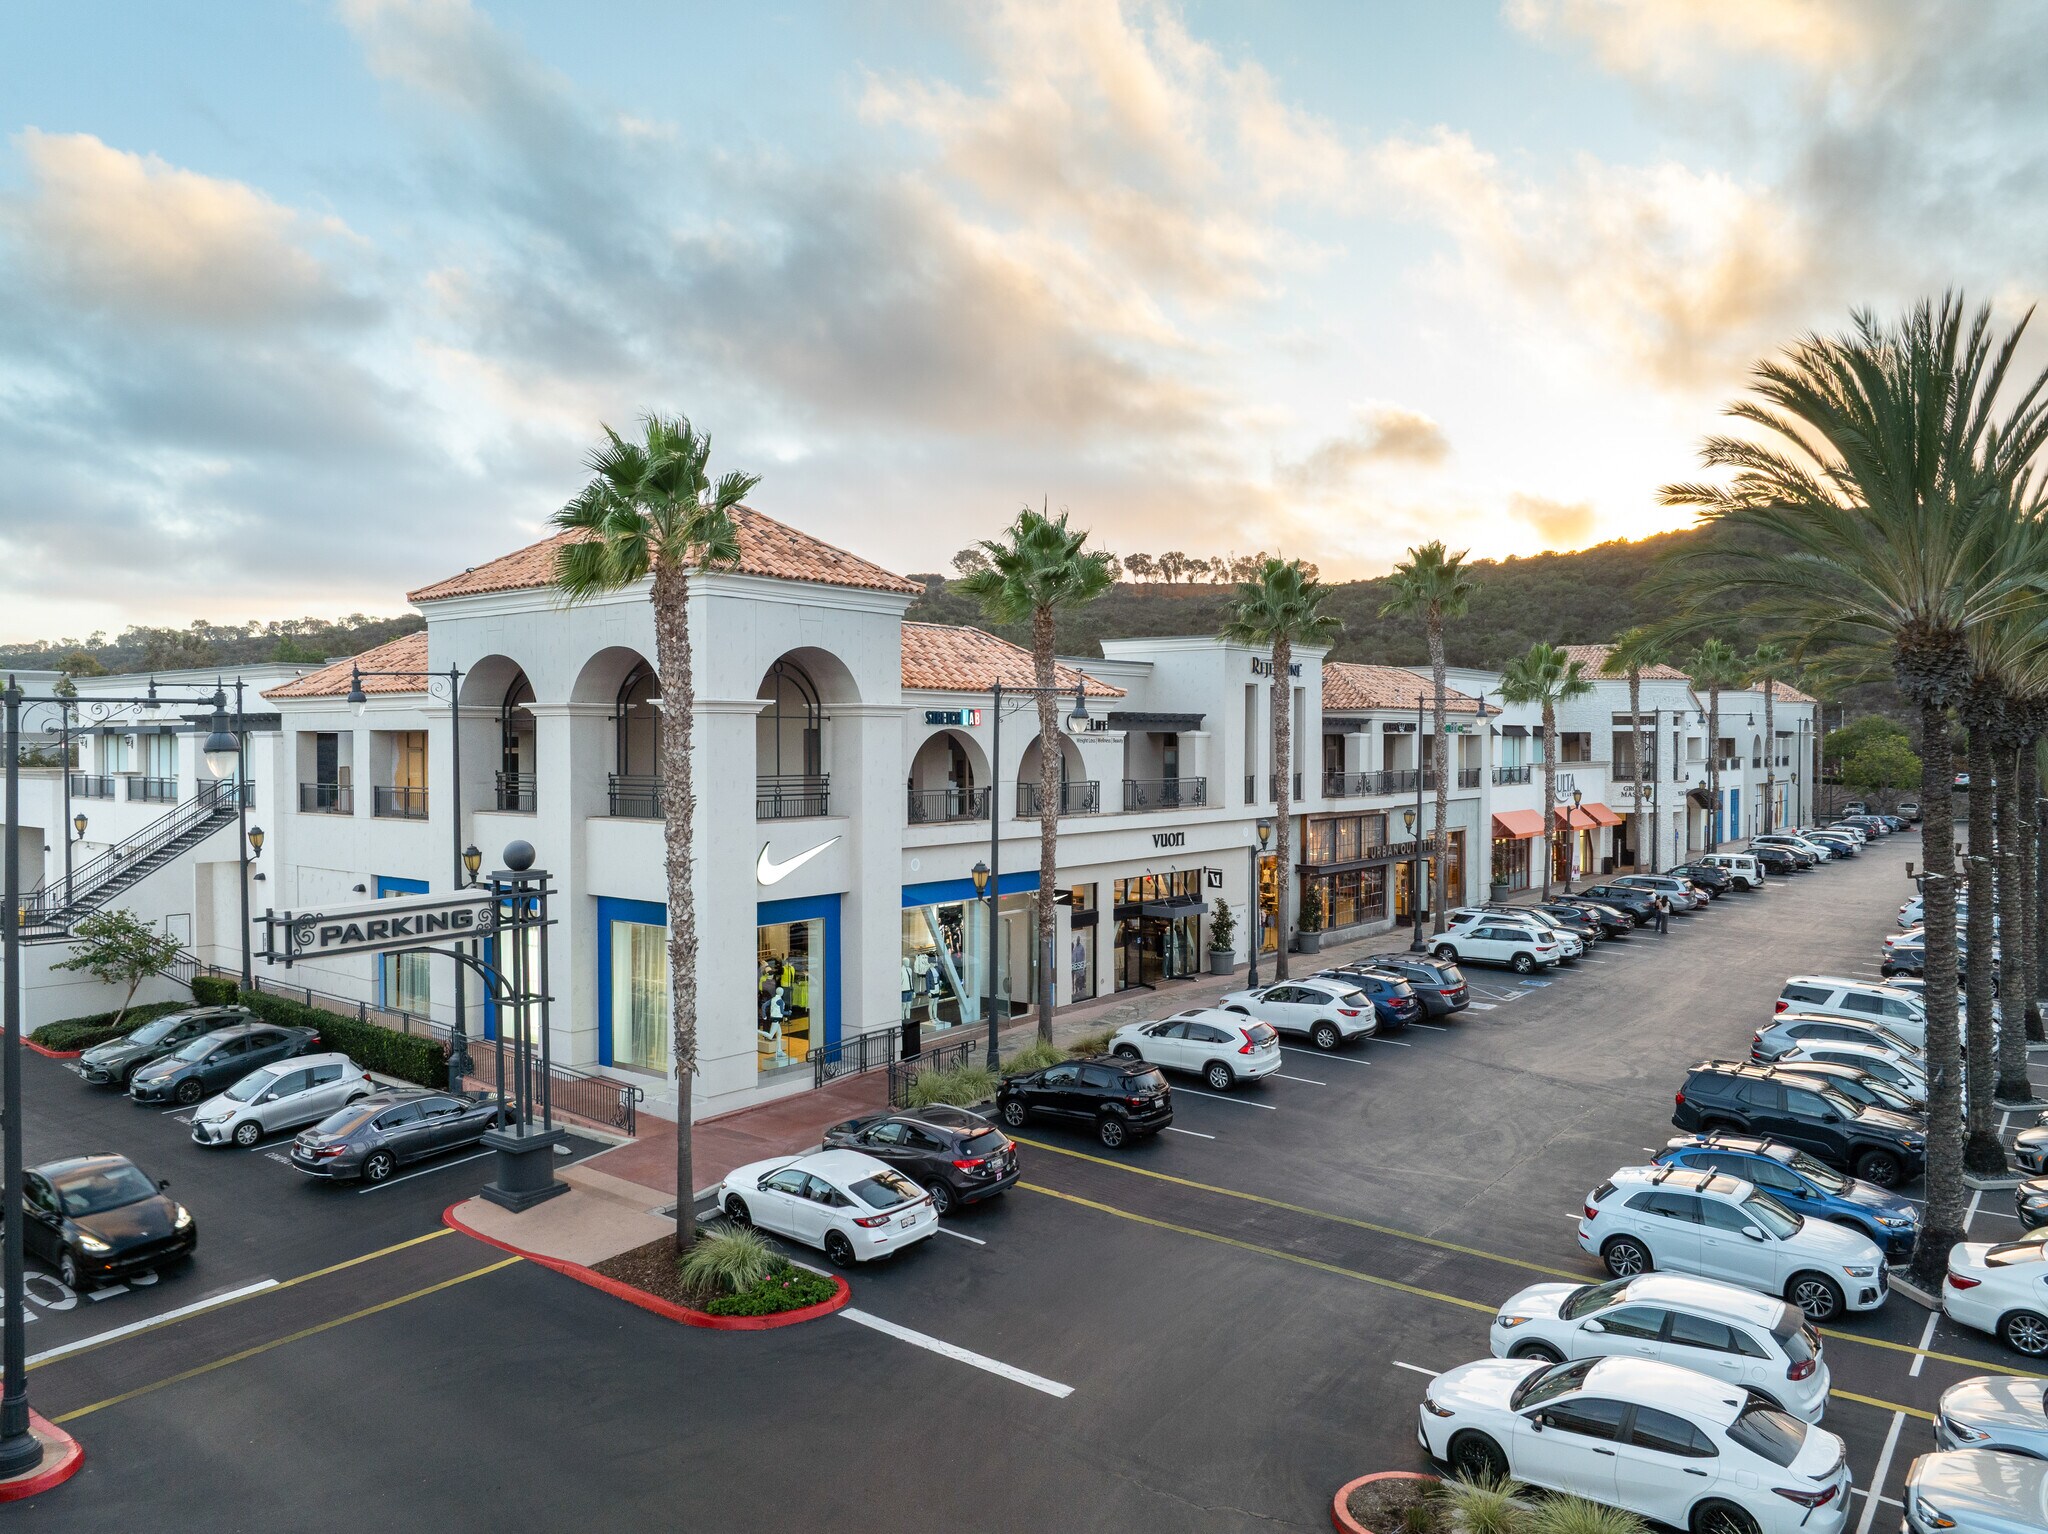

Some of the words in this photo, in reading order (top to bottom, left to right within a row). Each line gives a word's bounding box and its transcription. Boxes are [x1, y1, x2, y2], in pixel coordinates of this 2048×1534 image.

[1556, 773, 1576, 793] ULTA
[1371, 845, 1399, 859] URBAN
[320, 909, 473, 947] PARKING
